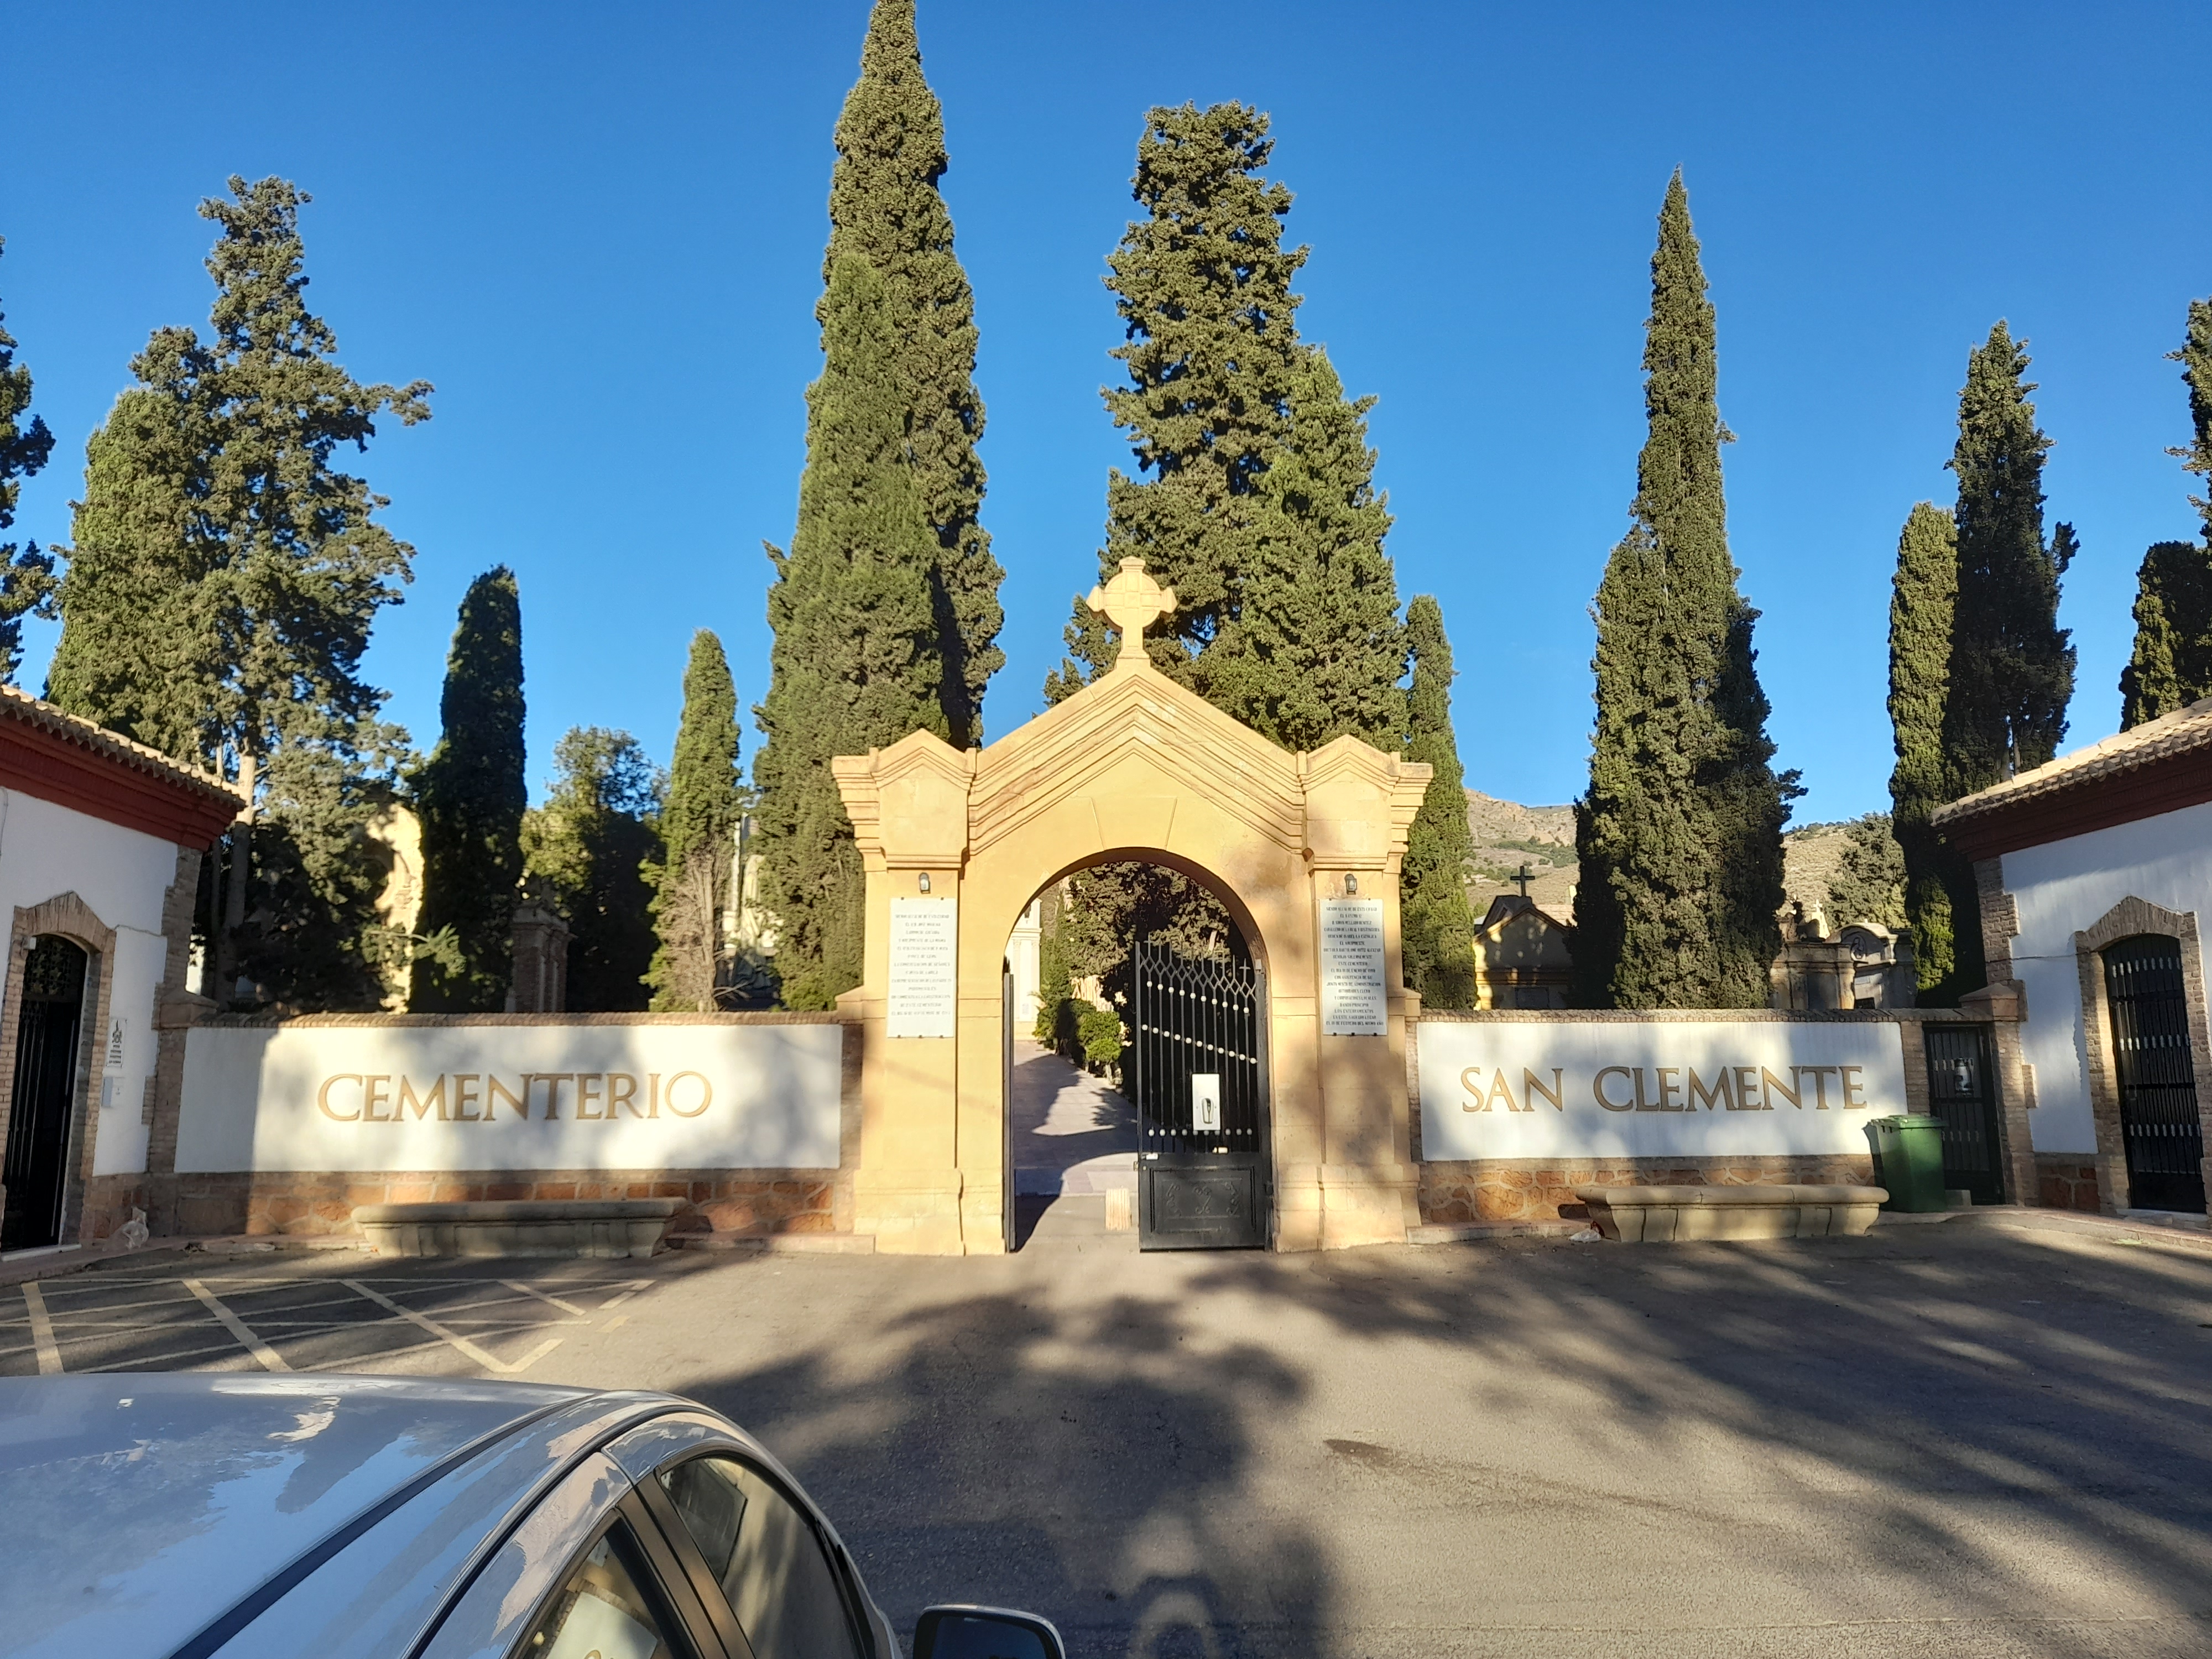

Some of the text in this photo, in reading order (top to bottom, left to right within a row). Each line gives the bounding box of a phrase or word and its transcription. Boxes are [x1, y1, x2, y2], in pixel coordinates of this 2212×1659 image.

[317, 1070, 713, 1123] CEMENTERIO
[1460, 1065, 1867, 1113] SAN CLEMENTE
